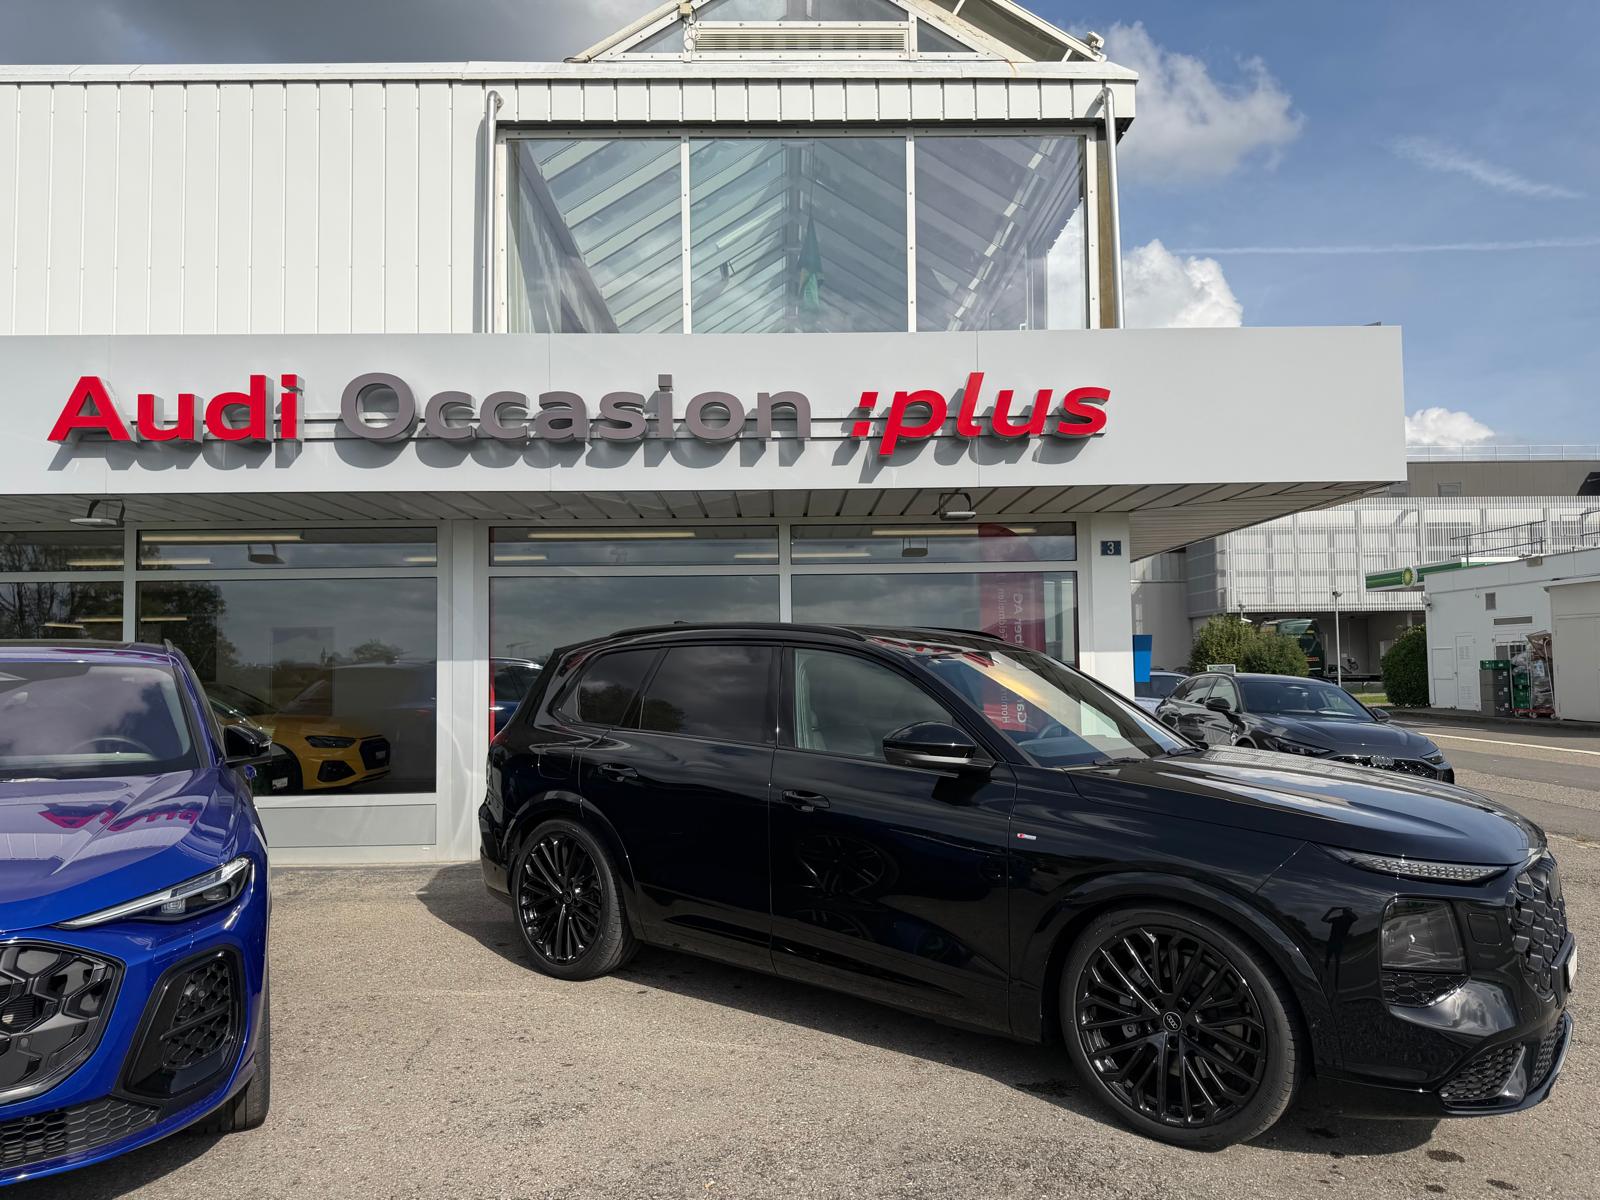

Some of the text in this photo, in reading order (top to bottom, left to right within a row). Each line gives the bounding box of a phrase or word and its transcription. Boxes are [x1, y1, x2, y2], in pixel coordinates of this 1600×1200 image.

[47, 374, 300, 442] Audi
[340, 372, 811, 443] Occasion
[1106, 541, 1115, 555] 3
